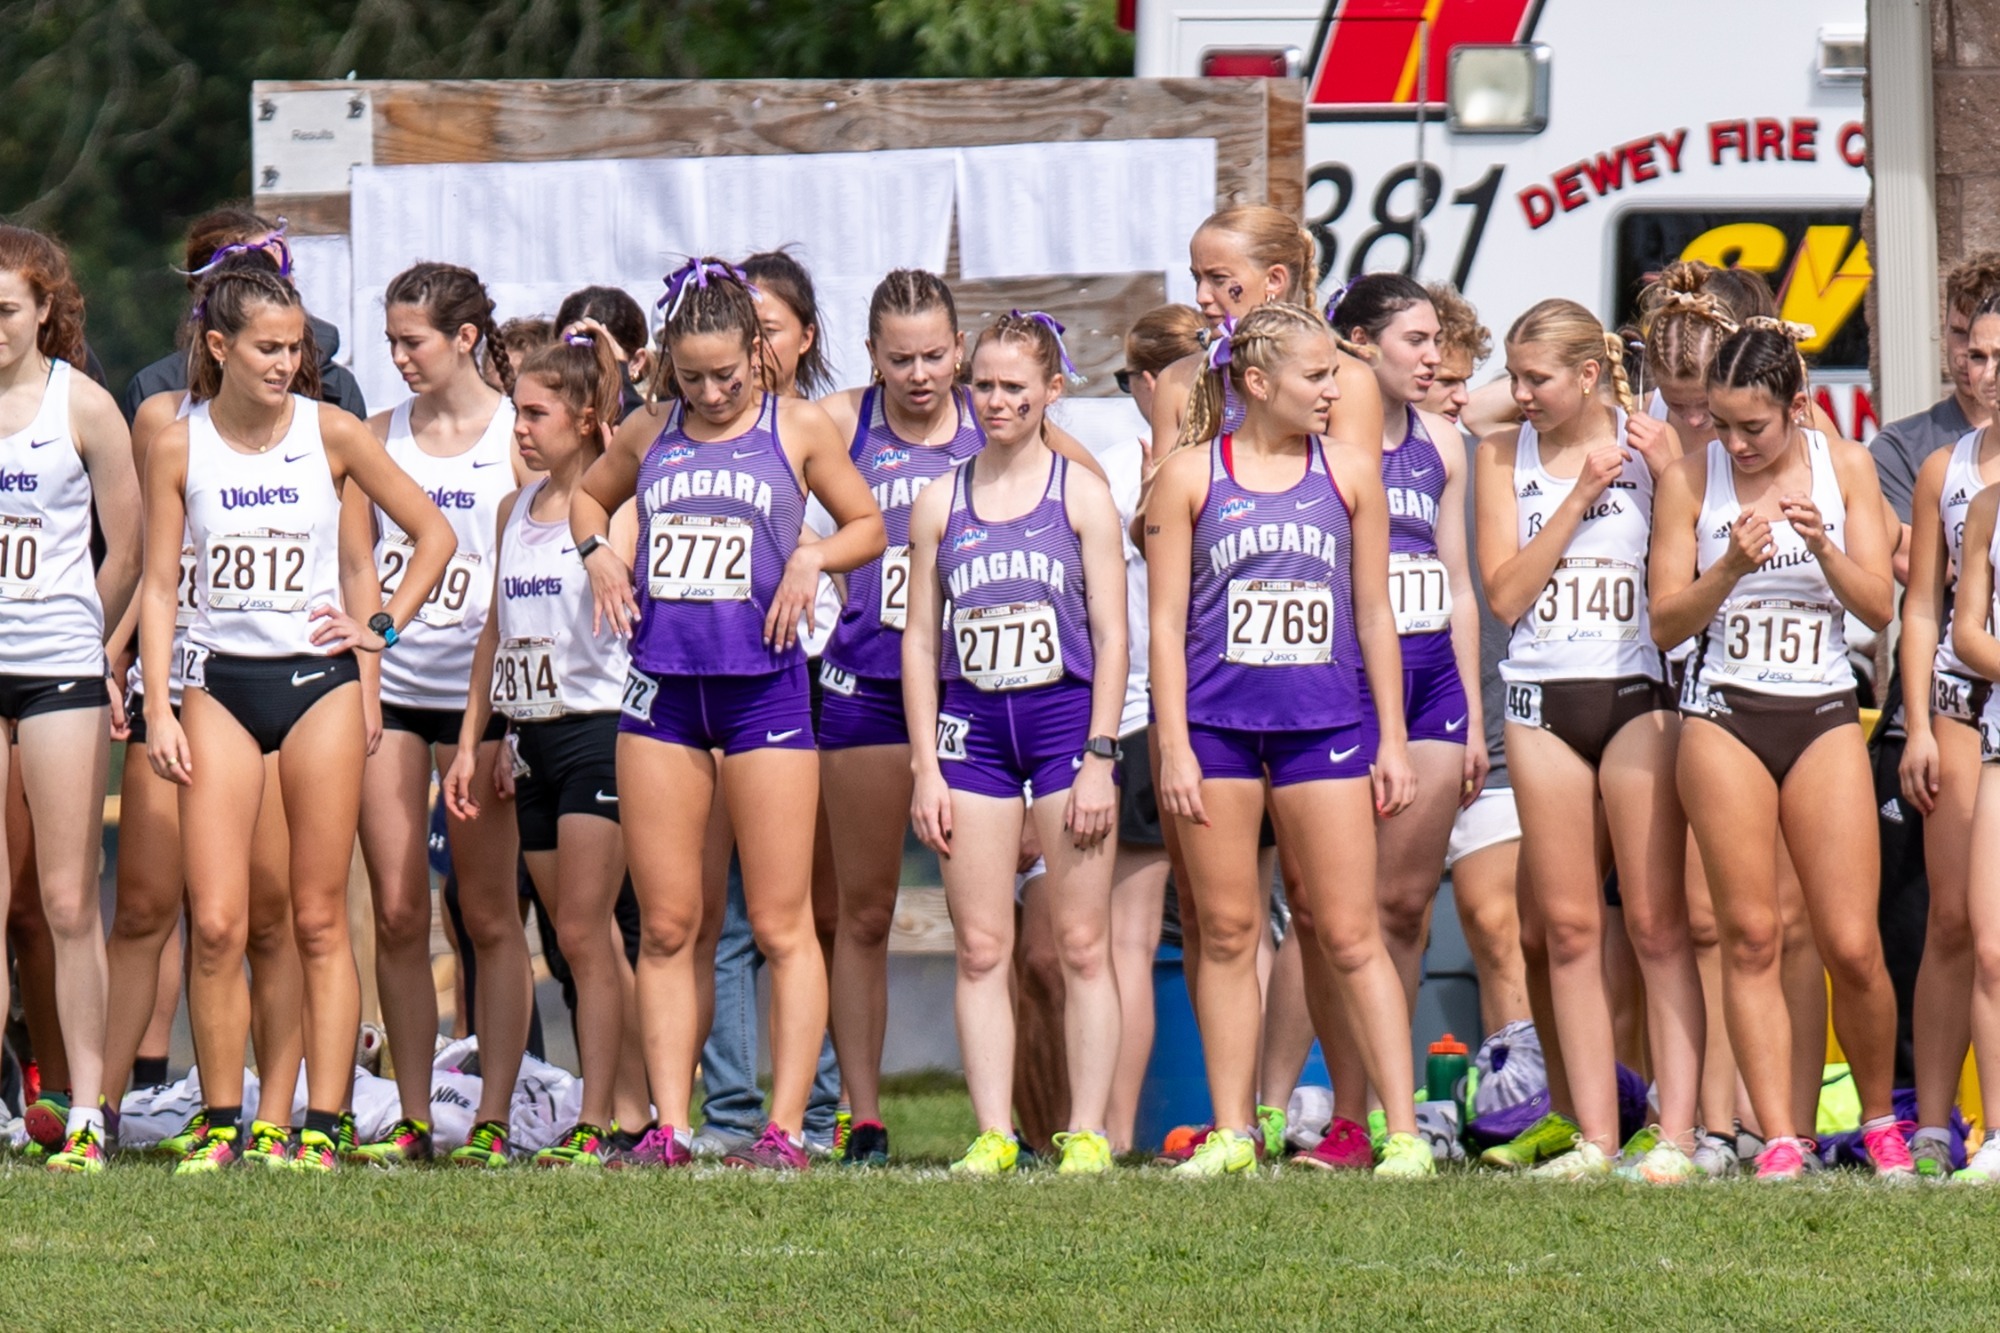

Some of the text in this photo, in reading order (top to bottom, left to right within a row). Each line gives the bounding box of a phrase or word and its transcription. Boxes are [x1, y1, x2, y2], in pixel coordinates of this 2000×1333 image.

[291, 129, 335, 141] Results
[1515, 115, 1866, 230] DEWEY FIRE C
[0, 469, 38, 492] lets
[872, 450, 911, 470] MAAC
[220, 484, 300, 511] Violets
[421, 485, 475, 510] olets
[643, 468, 773, 520] NIAGARA
[0, 534, 37, 580] 10
[211, 544, 306, 593] 2812
[652, 532, 747, 581] 2772
[1209, 522, 1336, 576] NIAGARA
[1758, 546, 1815, 573] nnie
[503, 574, 562, 600] Violets
[691, 587, 716, 597] asics
[948, 549, 1064, 598] NIAGARA
[1388, 568, 1444, 613] 777
[1231, 598, 1328, 645] 2769
[1538, 576, 1635, 623] 3140
[959, 618, 1055, 672] 2773
[1272, 652, 1298, 662] asics
[1728, 613, 1823, 665] 3151
[492, 653, 558, 702] 2814
[1004, 674, 1028, 686] asics
[1768, 672, 1793, 681] asics
[430, 1085, 471, 1109] NIKE
